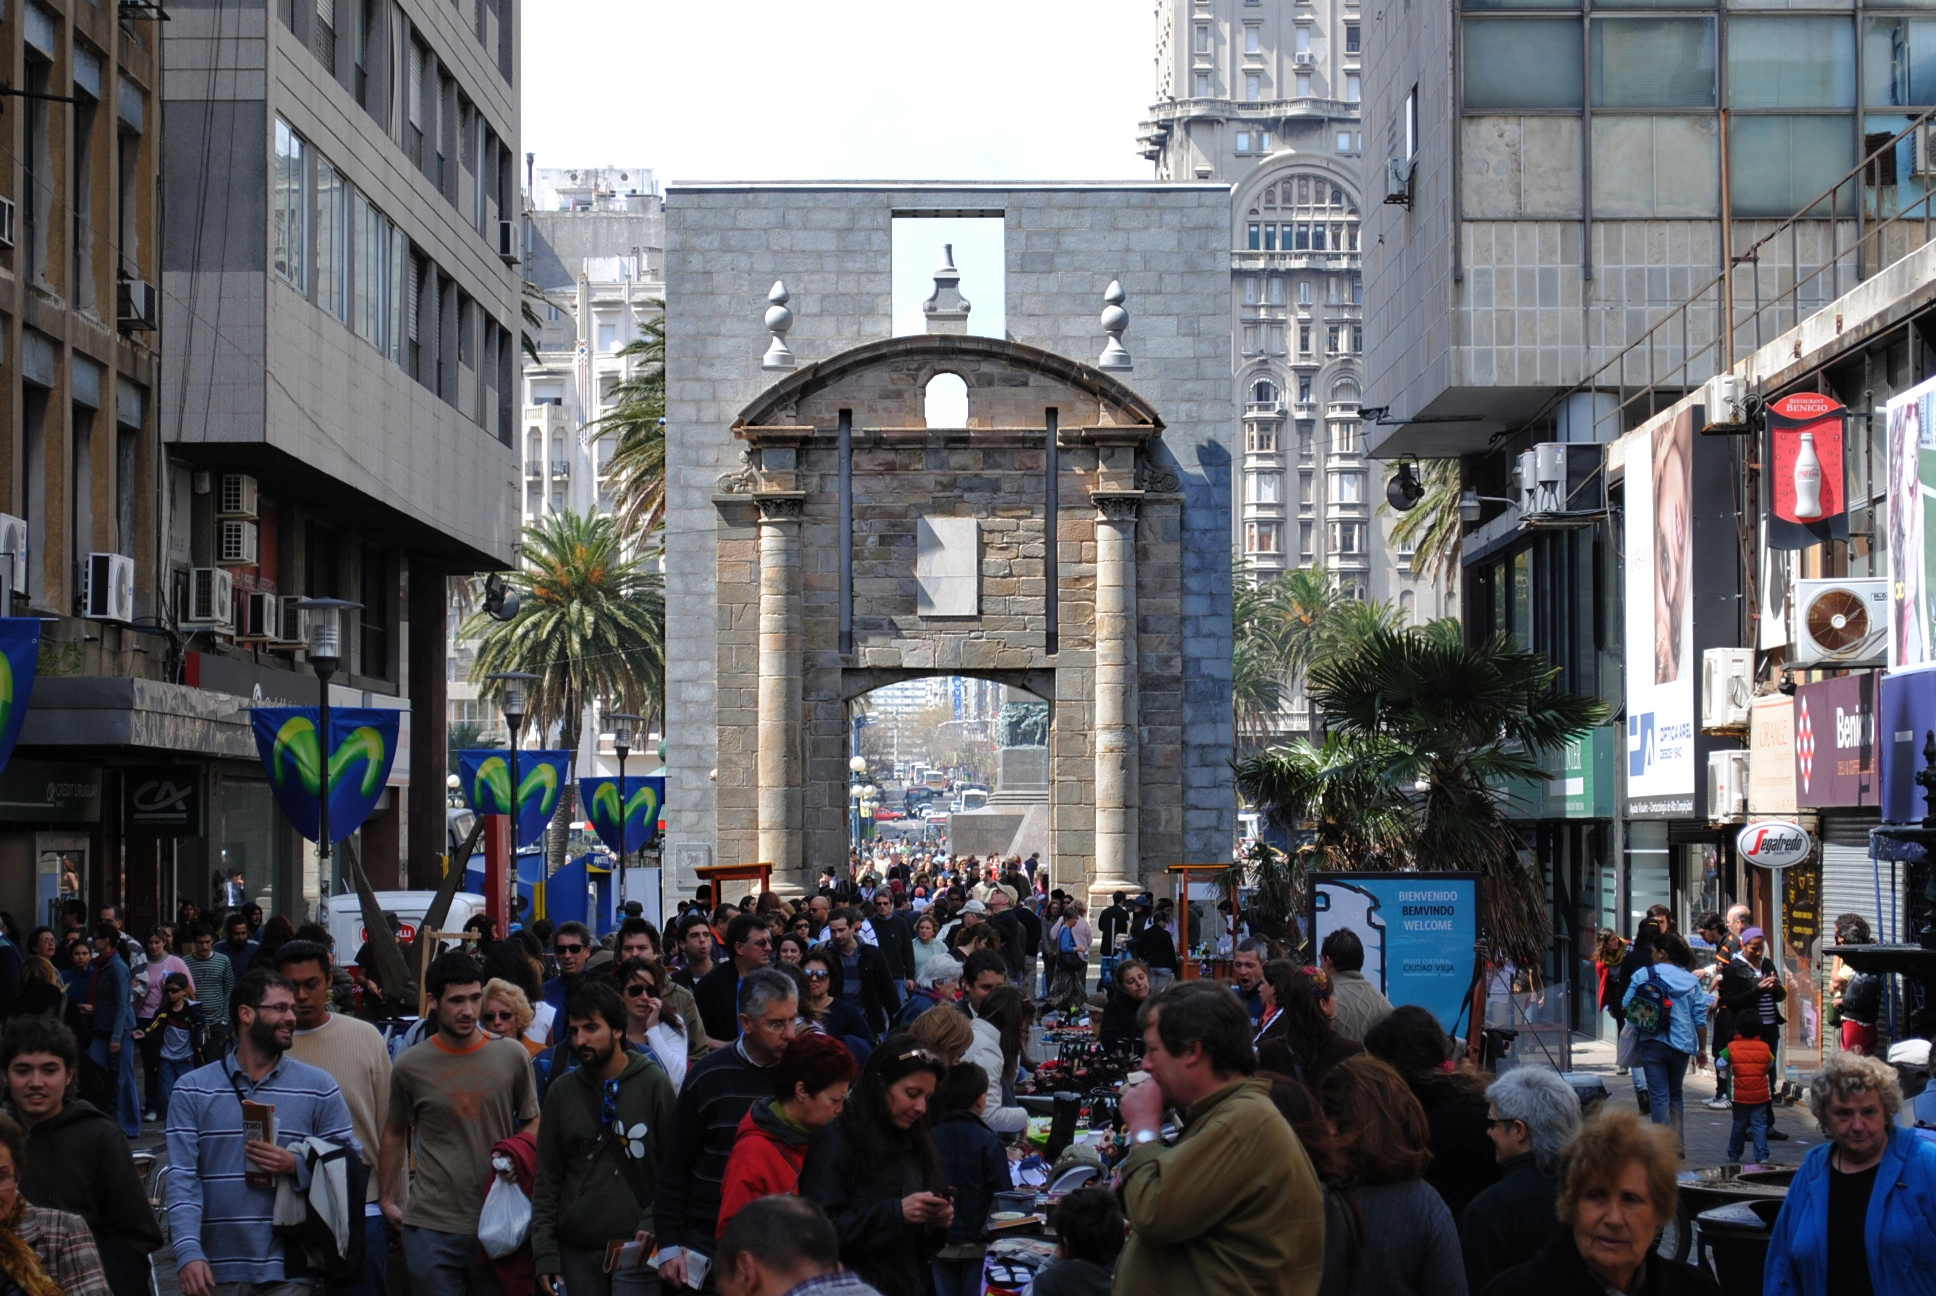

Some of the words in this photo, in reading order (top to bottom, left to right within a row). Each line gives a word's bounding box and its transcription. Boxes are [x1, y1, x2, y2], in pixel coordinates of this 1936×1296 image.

[1786, 404, 1828, 412] BENICIO
[1836, 704, 1875, 749] Benicio
[1660, 725, 1678, 742] OPTICA
[1759, 719, 1789, 748] ORANGE
[74, 783, 99, 798] URUGUAY
[1747, 829, 1803, 856] Segafredo
[593, 855, 610, 865] ANTEL
[1398, 890, 1458, 902] BIENVENIDO
[1402, 905, 1455, 916] BEMVINDO
[1403, 920, 1453, 931] WELCOME
[1402, 964, 1433, 972] CIUDAD
[1435, 964, 1455, 973] VIEJA
